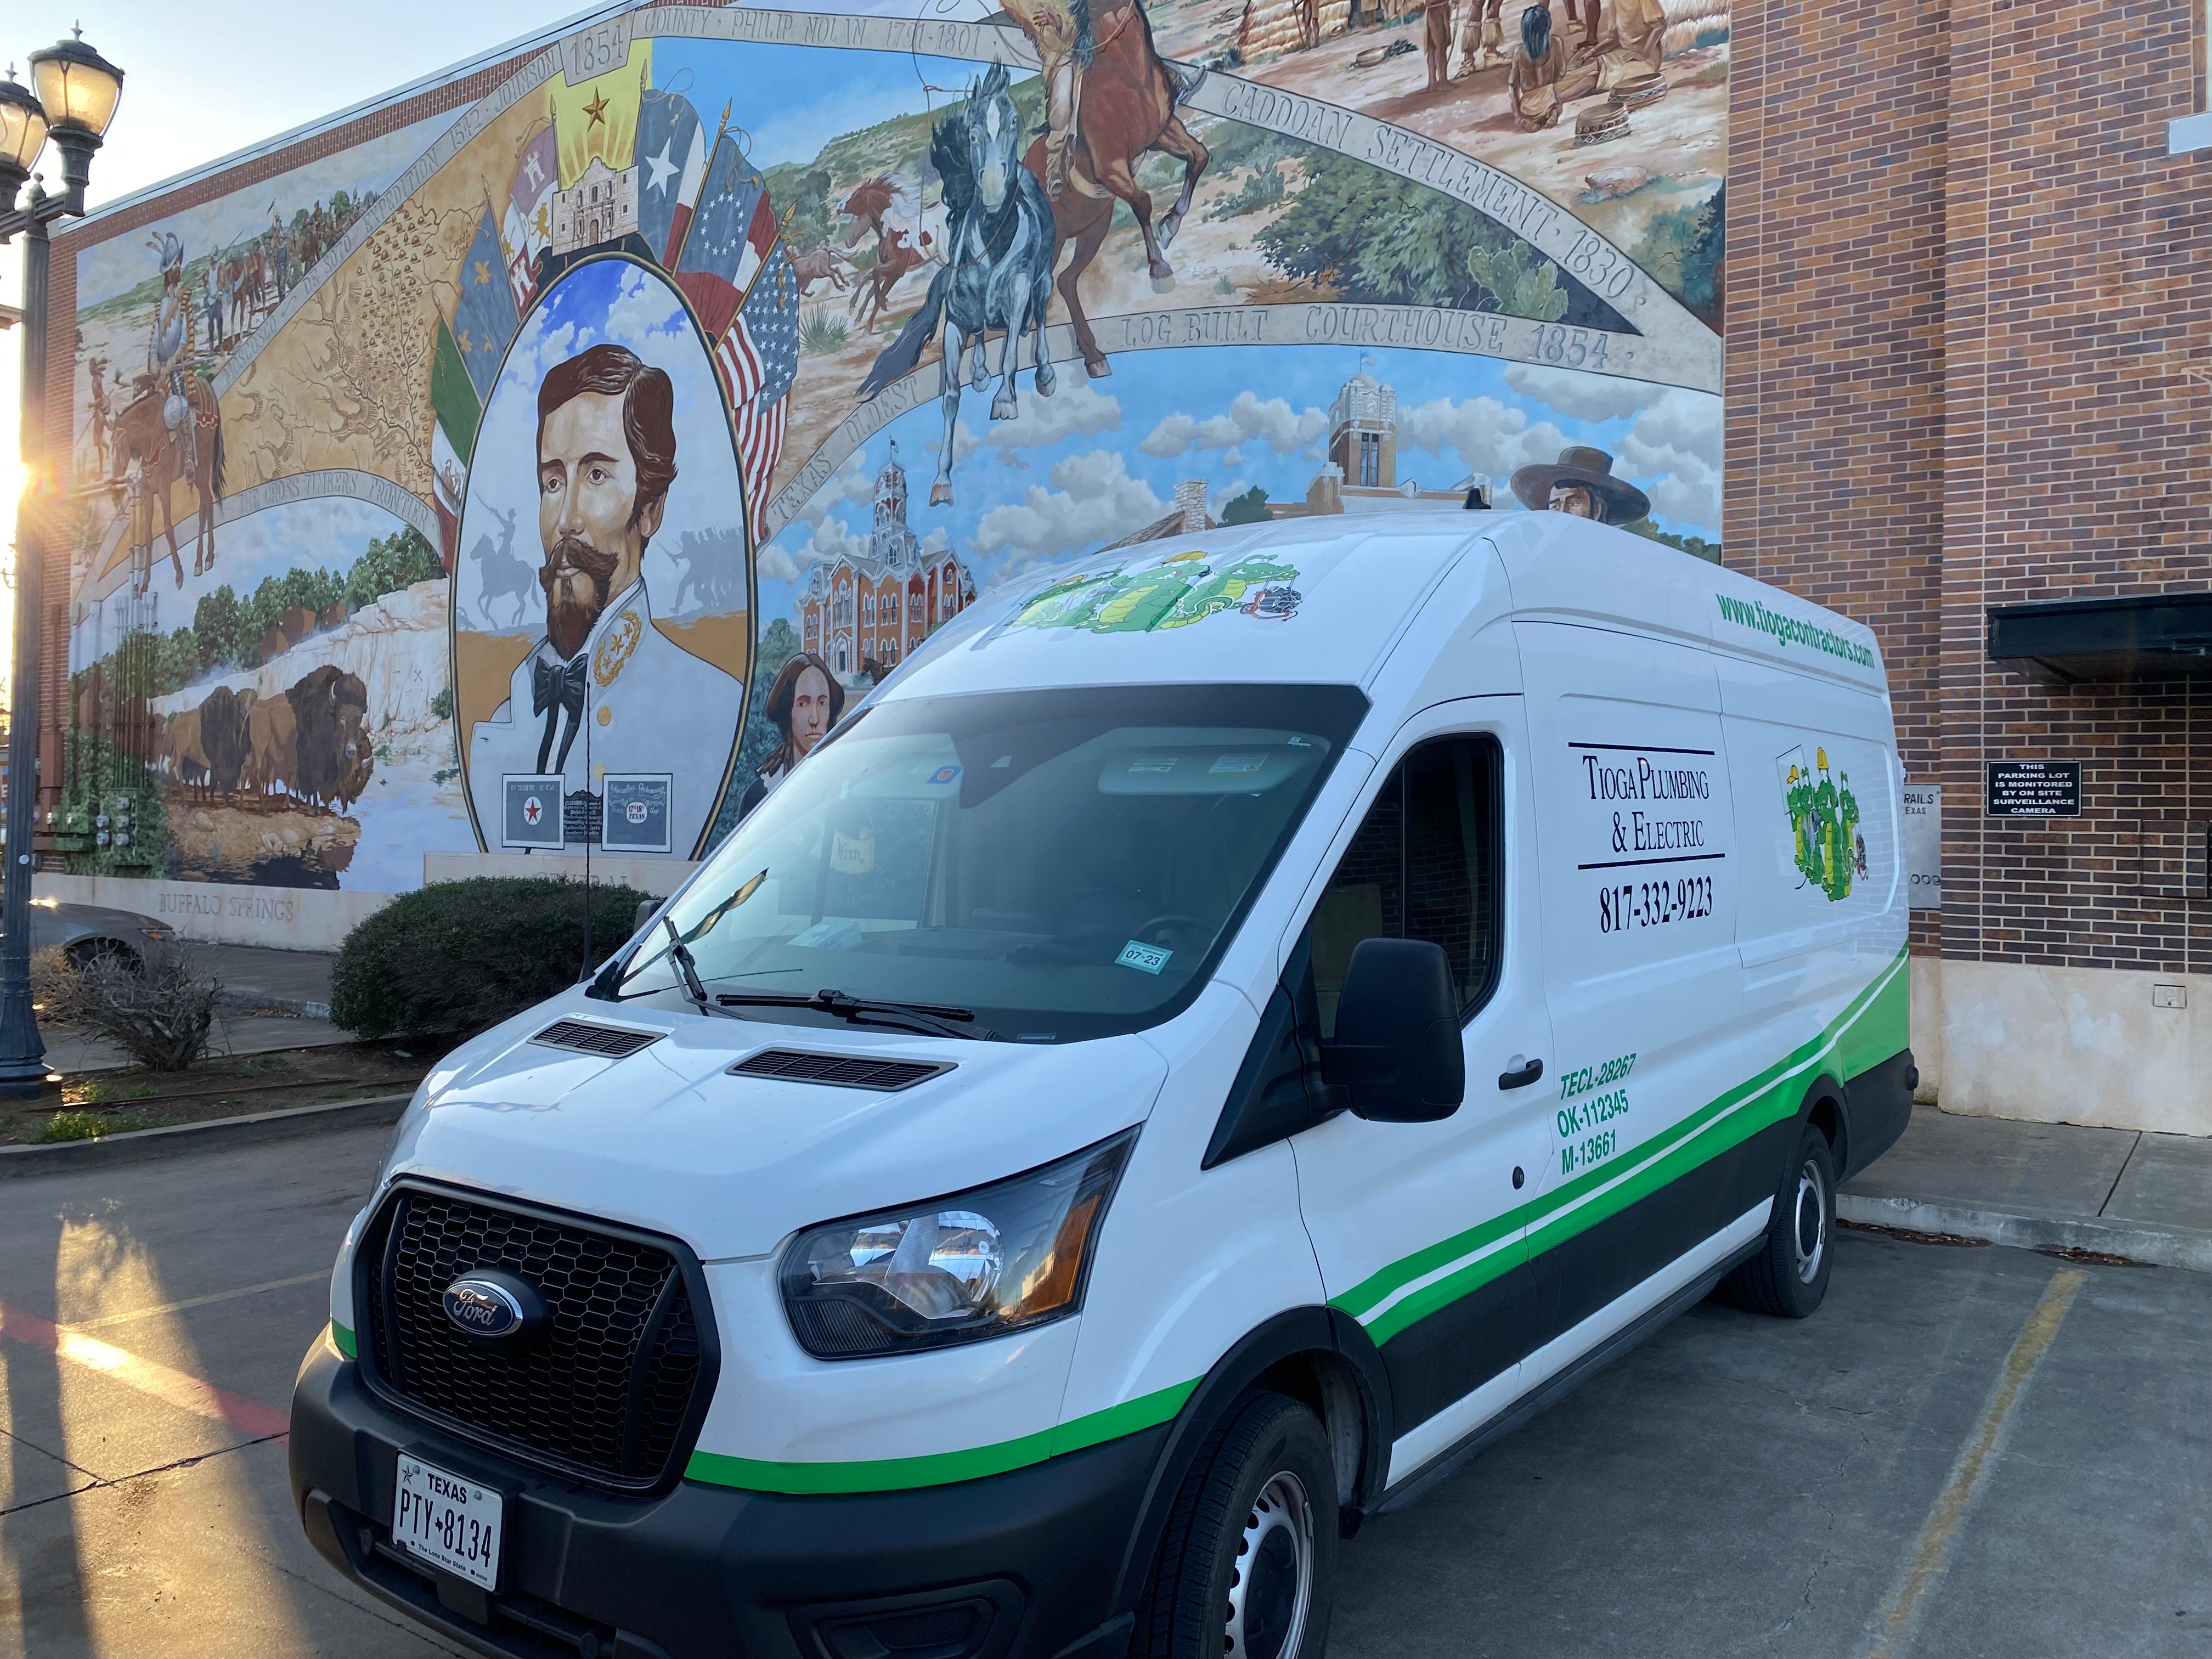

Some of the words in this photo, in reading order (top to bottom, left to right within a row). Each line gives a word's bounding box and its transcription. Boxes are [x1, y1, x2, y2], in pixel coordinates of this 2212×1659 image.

[644, 5, 709, 35] COUNTY
[730, 10, 793, 40] PHILIP
[804, 15, 866, 47] NOLAN
[570, 23, 625, 78] 1854
[495, 50, 556, 112] JOHNSON
[325, 234, 352, 274] SOTO
[364, 148, 439, 233] EXPEDITION
[450, 109, 482, 151] 1542
[1221, 81, 1352, 150] CADDOAN
[1365, 123, 1561, 240] SETTLEMENT
[1558, 229, 1635, 299] 1830
[770, 449, 833, 525] TEXAS
[844, 375, 922, 445] OLDEST
[1120, 314, 1171, 348] LOG
[1183, 309, 1269, 343] BUILT
[1304, 308, 1508, 352] COURTHOUSE
[1528, 324, 1609, 370] 1854
[238, 488, 259, 515] THE
[264, 476, 300, 505] CROSS
[304, 471, 358, 496] TIMBERS
[368, 476, 428, 532] FRONTIER
[1716, 593, 1876, 670] www.tiogacontractors.com
[1583, 755, 1637, 800] TIOGA
[1637, 757, 1710, 800] PLUMBING
[1612, 811, 1628, 854] &
[1633, 811, 1705, 851] ELECTRIC
[1905, 806, 1927, 815] EXAS
[158, 893, 221, 915] BUFFALO
[229, 896, 294, 922] SPRINGS
[1599, 876, 1713, 934] 817-332-9223
[1126, 950, 1142, 960] 07
[1143, 955, 1160, 966] 23
[1560, 1053, 1637, 1101] TECL-28267
[1557, 1088, 1629, 1138] OK-112345
[1562, 1128, 1616, 1175] M-13661
[453, 1288, 498, 1326] Ford
[427, 1472, 467, 1504] TEXAS
[399, 1488, 433, 1539] PTY
[443, 1509, 492, 1568] 8134
[419, 1544, 427, 1554] The
[428, 1548, 440, 1560] Lone
[441, 1555, 452, 1565] Star
[453, 1560, 466, 1572] State
